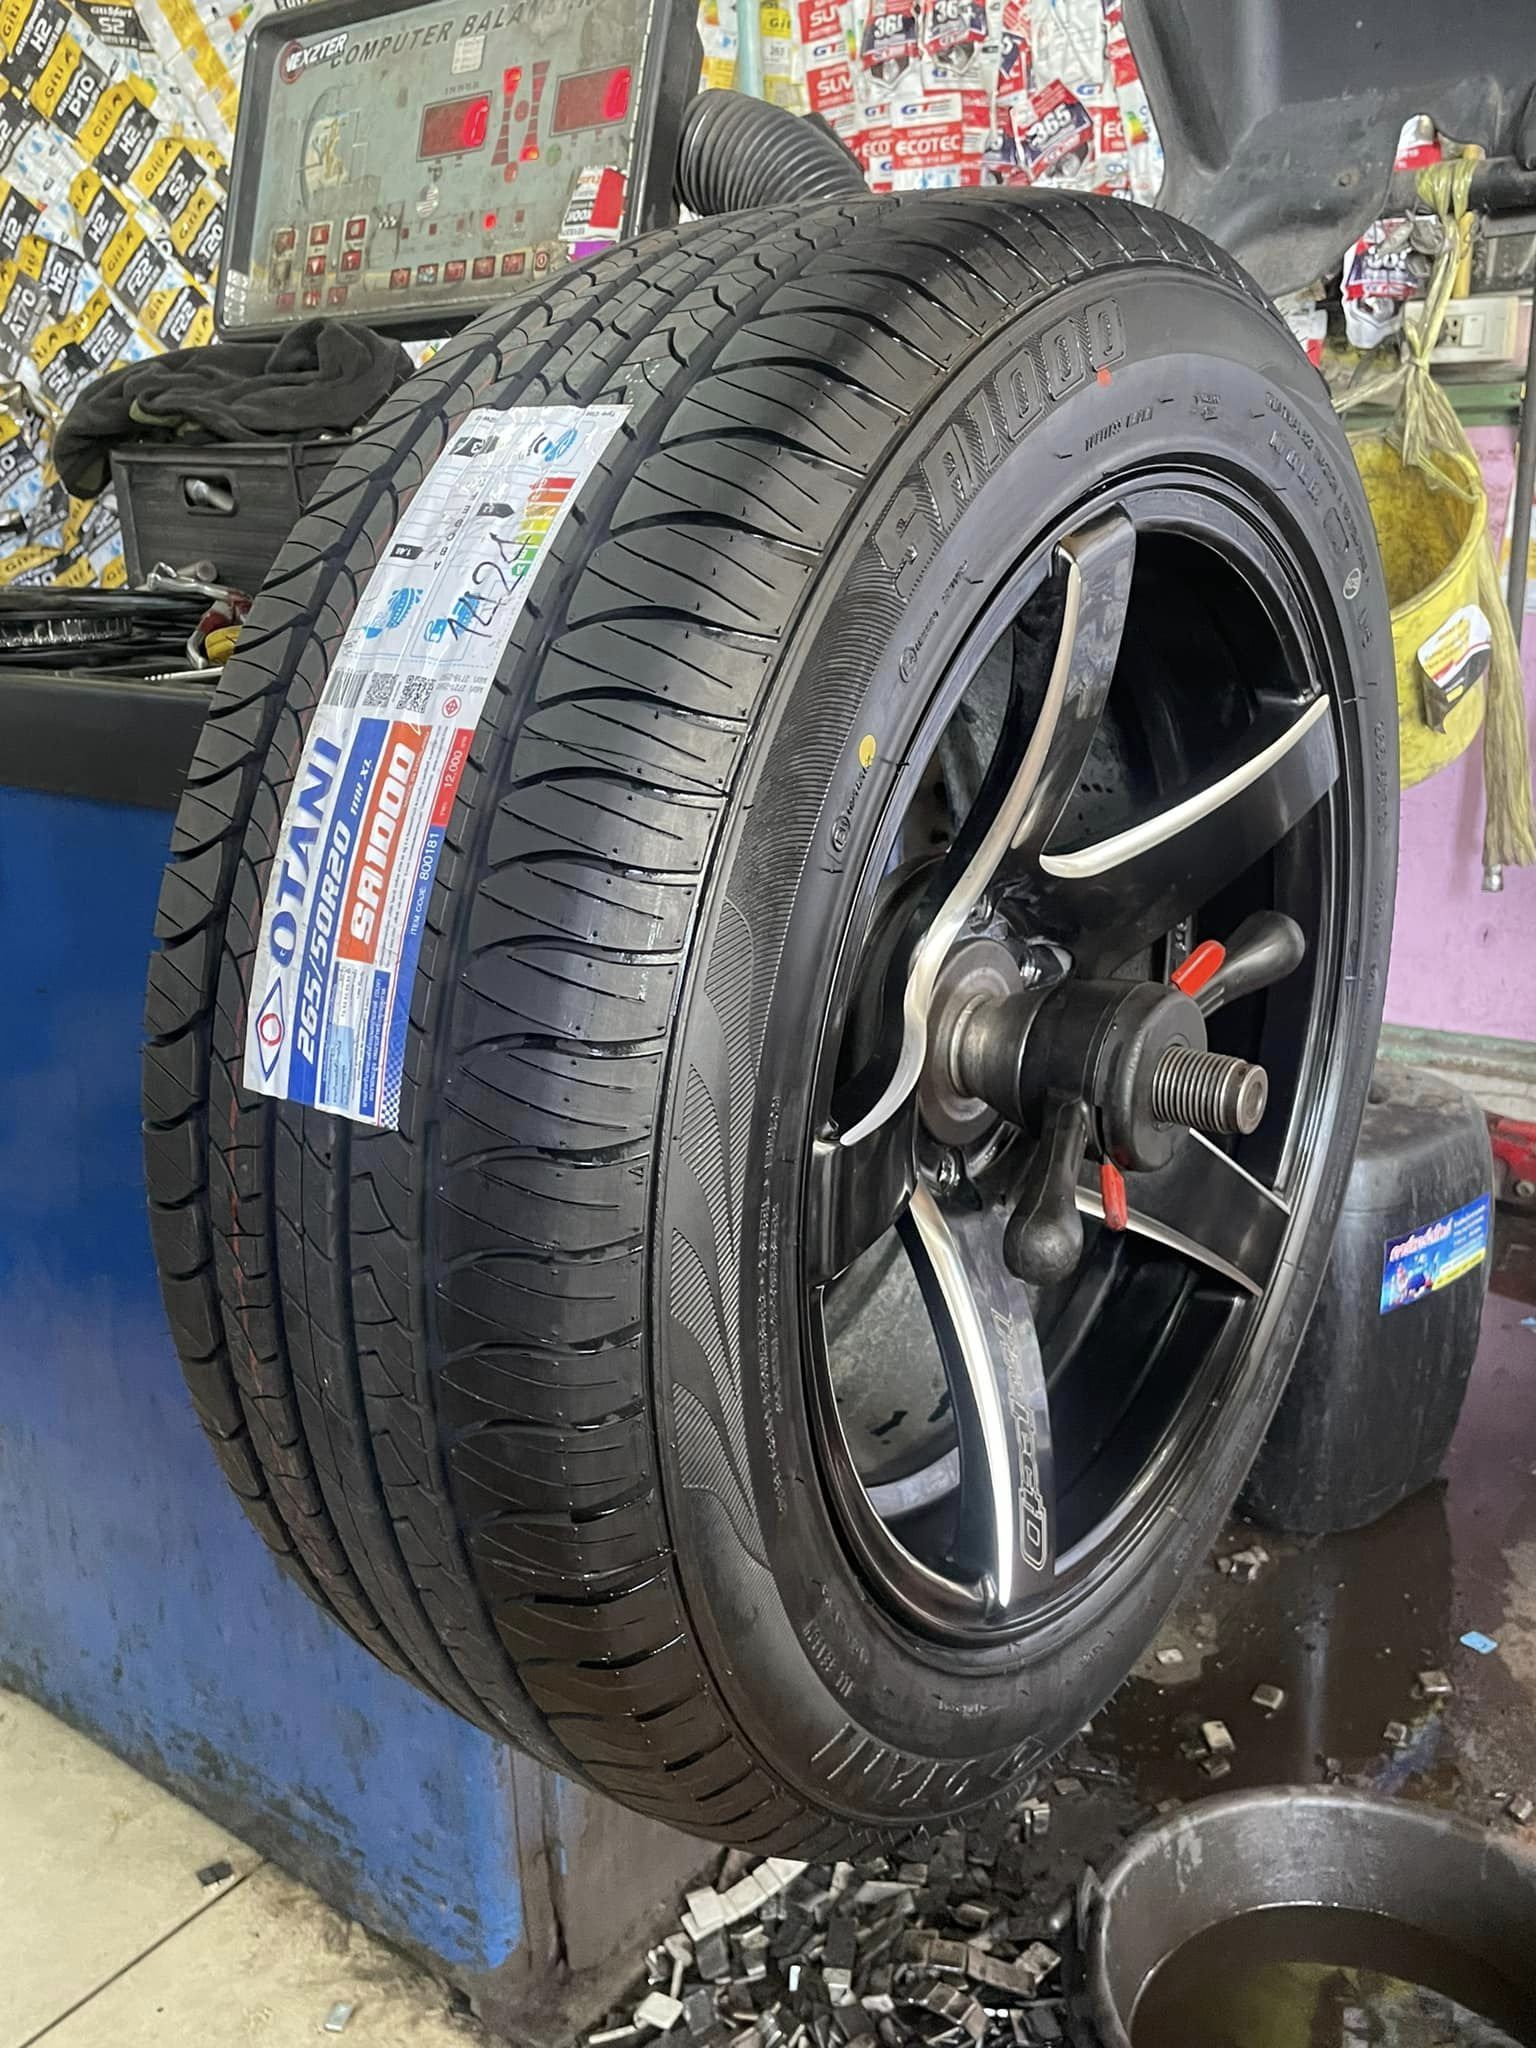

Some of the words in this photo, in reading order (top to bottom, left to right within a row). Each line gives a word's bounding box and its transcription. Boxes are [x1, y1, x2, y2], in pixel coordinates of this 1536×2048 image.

[30, 18, 52, 53] H2
[98, 17, 125, 34] S2
[68, 75, 95, 118] P10
[817, 77, 852, 96] SUV
[901, 103, 931, 115] GT
[1027, 103, 1072, 147] 365
[119, 125, 141, 155] H2
[169, 173, 189, 202] S2
[2, 218, 22, 250] H2
[88, 212, 109, 243] H2
[49, 260, 70, 294] H2
[9, 289, 36, 339] AT70
[170, 301, 196, 342] F22
[269, 737, 343, 969] OTANI
[350, 742, 416, 946] SA1000
[419, 832, 440, 881] 800181
[297, 822, 351, 1066] 265/50R20
[359, 757, 373, 780] XL
